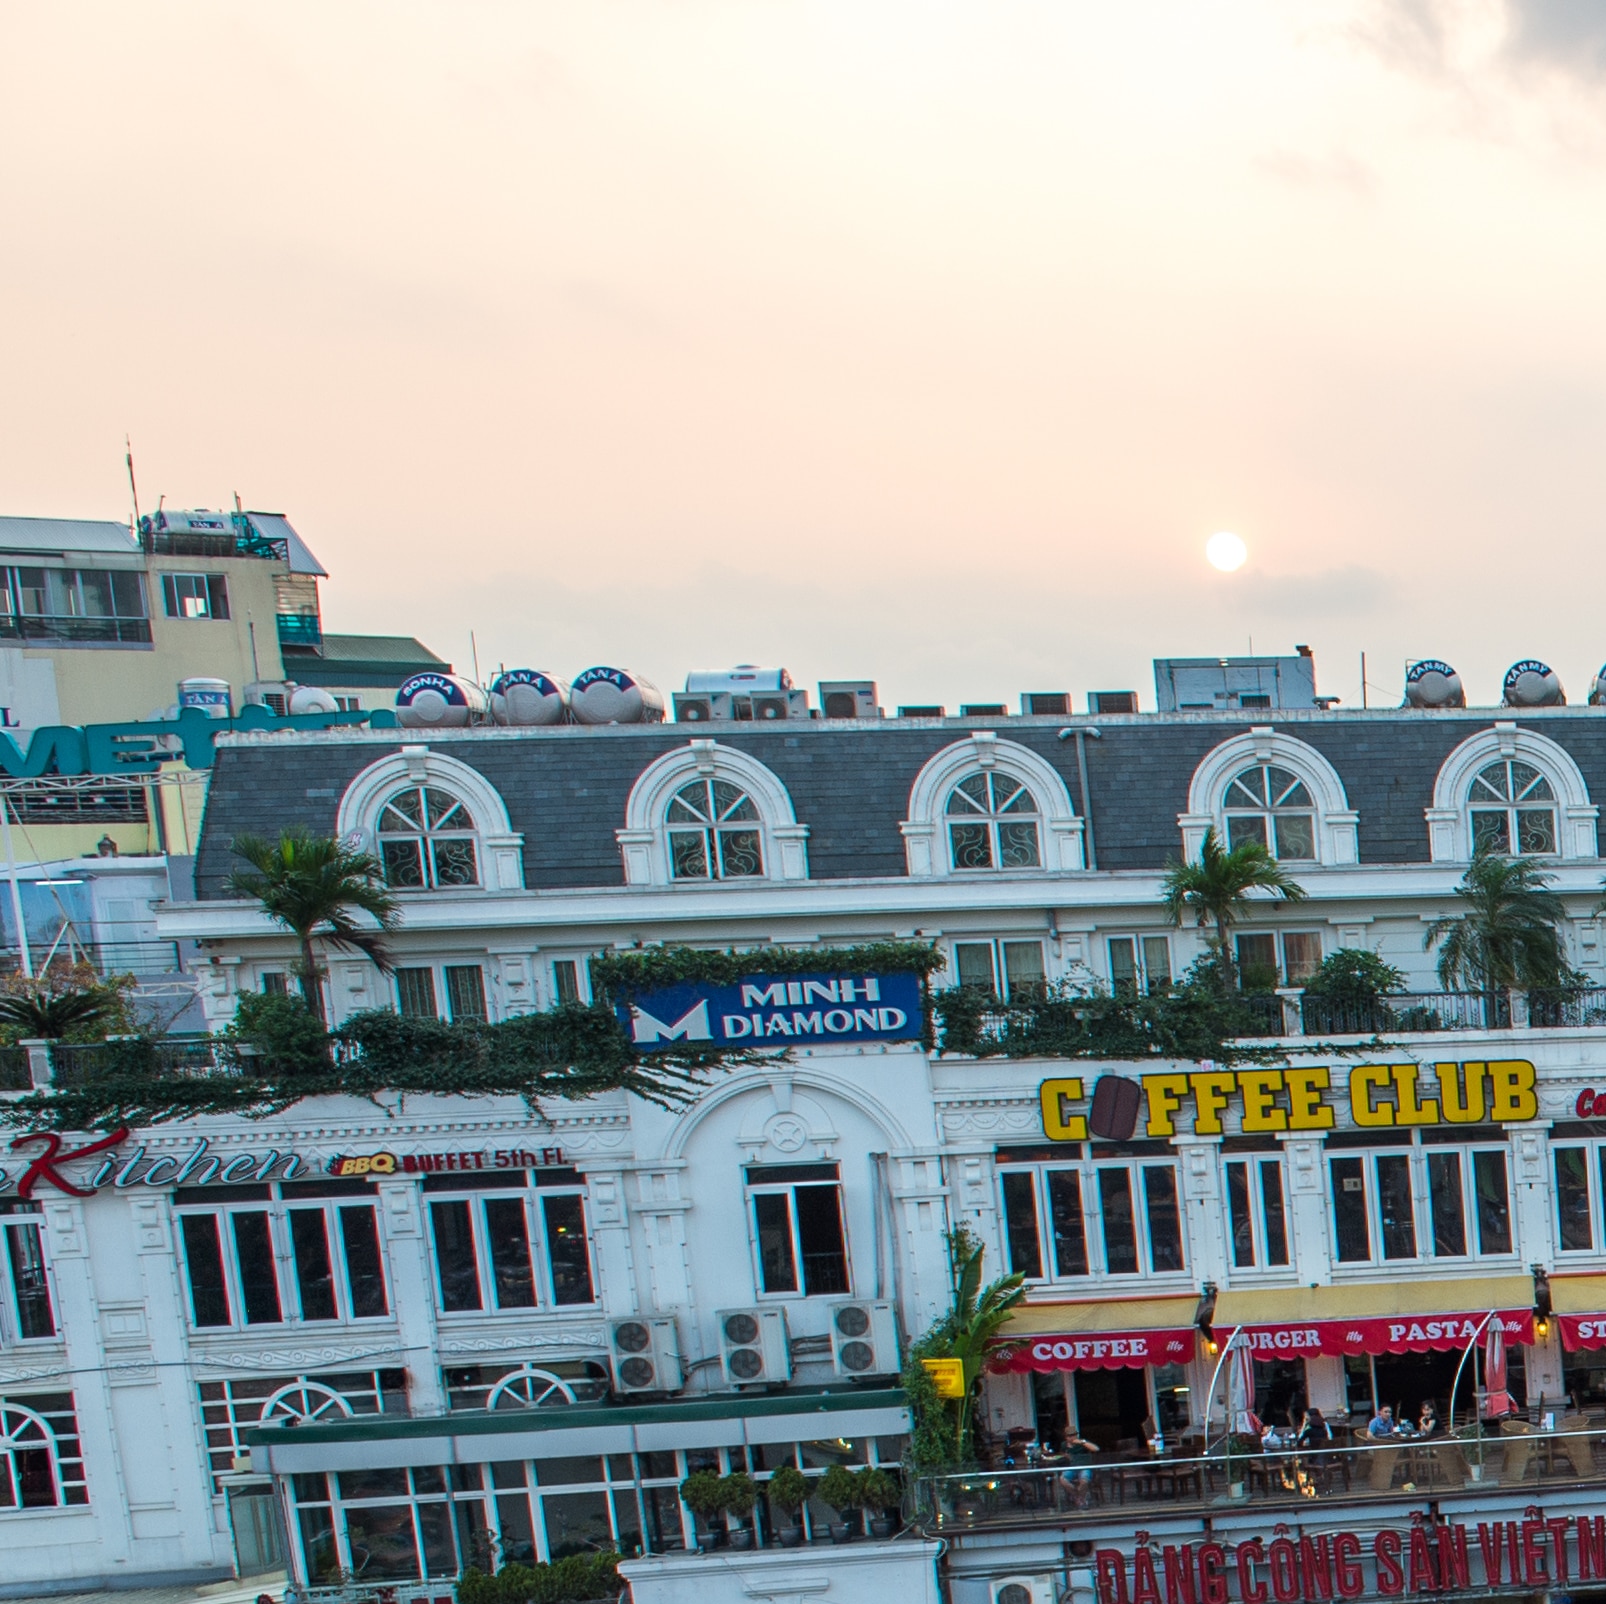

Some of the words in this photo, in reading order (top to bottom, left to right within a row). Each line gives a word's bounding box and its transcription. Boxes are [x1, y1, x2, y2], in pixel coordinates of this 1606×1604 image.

[741, 978, 882, 1008] MINH
[723, 1007, 908, 1040] DIAMOND
[1348, 1059, 1539, 1128] CLUB
[10, 1127, 306, 1200] Kitchen
[340, 1152, 396, 1174] BBQ
[402, 1151, 486, 1173] BUFFET
[494, 1150, 535, 1169] 5th
[1346, 1330, 1364, 1343] illy
[1389, 1323, 1479, 1342] PASTA
[1032, 1338, 1149, 1361] COFFEE
[1166, 1340, 1185, 1353] illy
